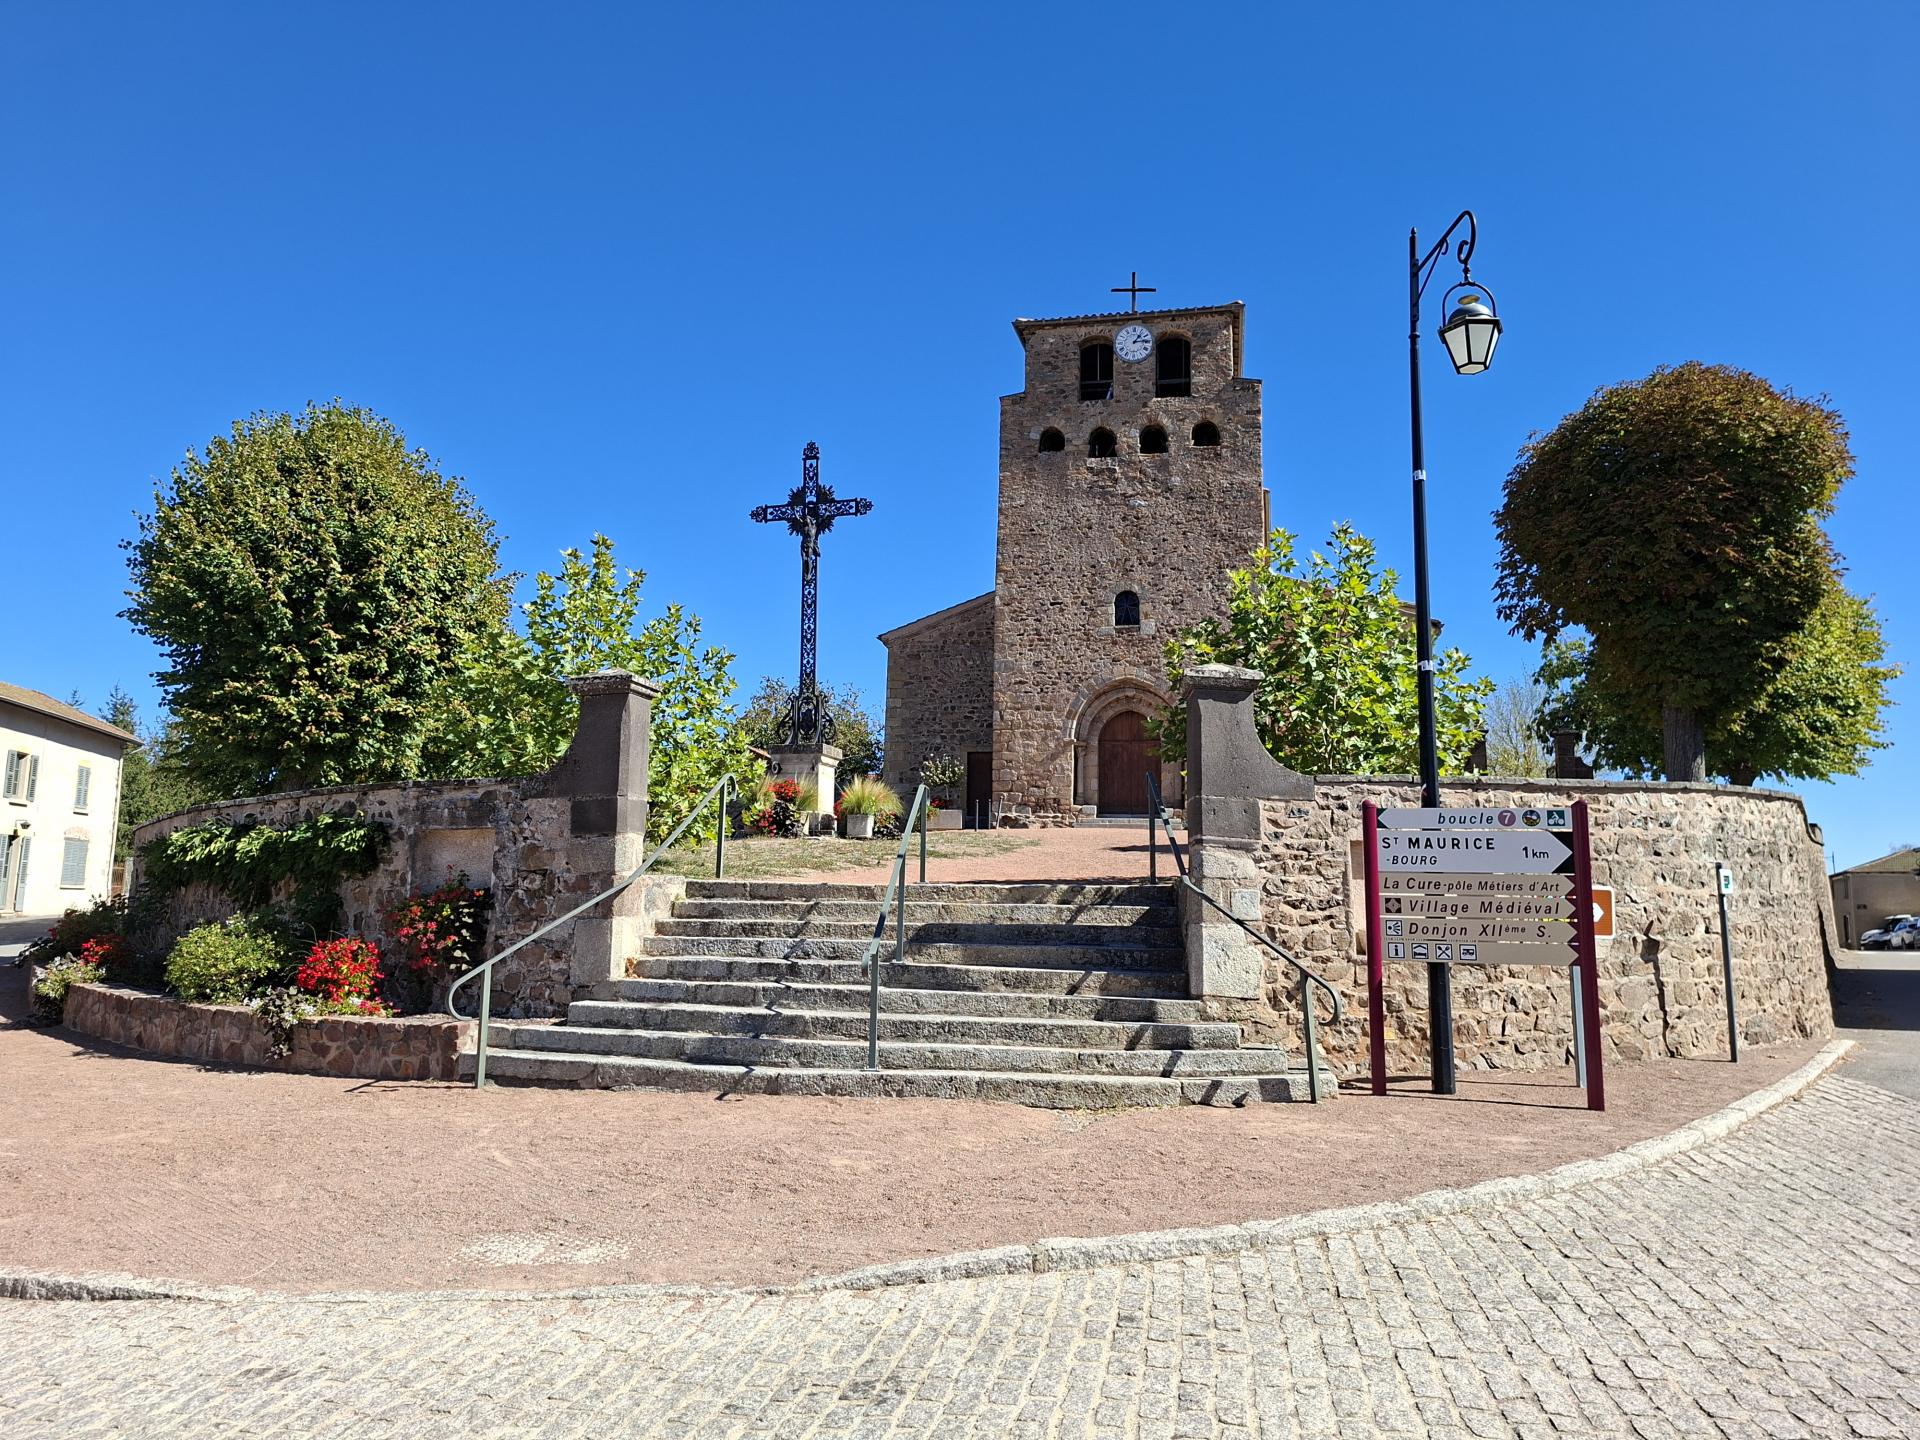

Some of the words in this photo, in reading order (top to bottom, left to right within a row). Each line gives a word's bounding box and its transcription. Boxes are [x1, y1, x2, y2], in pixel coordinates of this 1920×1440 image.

[1437, 812, 1494, 825] boucle
[1502, 812, 1511, 825] 7
[1407, 837, 1495, 850] MAURICE
[1383, 877, 1400, 889] La
[1477, 880, 1524, 891] Métiers
[1529, 881, 1560, 892] d'Art
[1409, 900, 1469, 916] Village
[1479, 901, 1560, 914] Médiéval
[1408, 922, 1468, 938] Donjon
